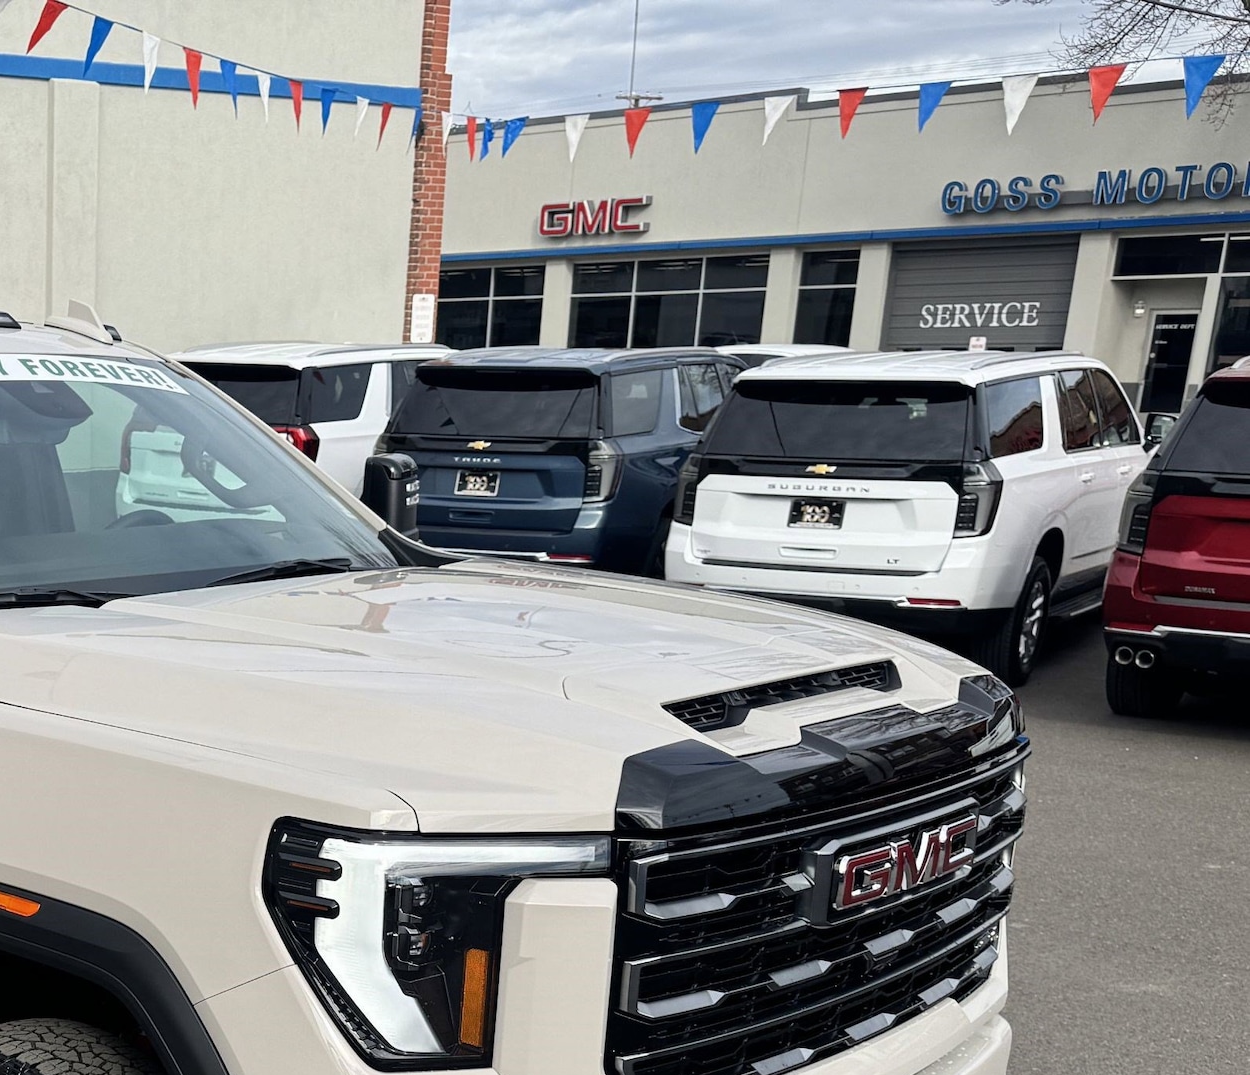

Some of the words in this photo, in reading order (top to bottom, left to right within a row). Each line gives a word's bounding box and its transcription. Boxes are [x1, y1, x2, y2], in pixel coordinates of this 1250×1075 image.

[940, 174, 1065, 215] GOSS
[538, 196, 652, 237] GMC
[919, 301, 1041, 329] SERVICE
[26, 358, 177, 390] FOREVER!
[453, 456, 502, 464] TAHOE
[767, 484, 871, 493] SUBURBAN
[833, 812, 978, 911] GMC
